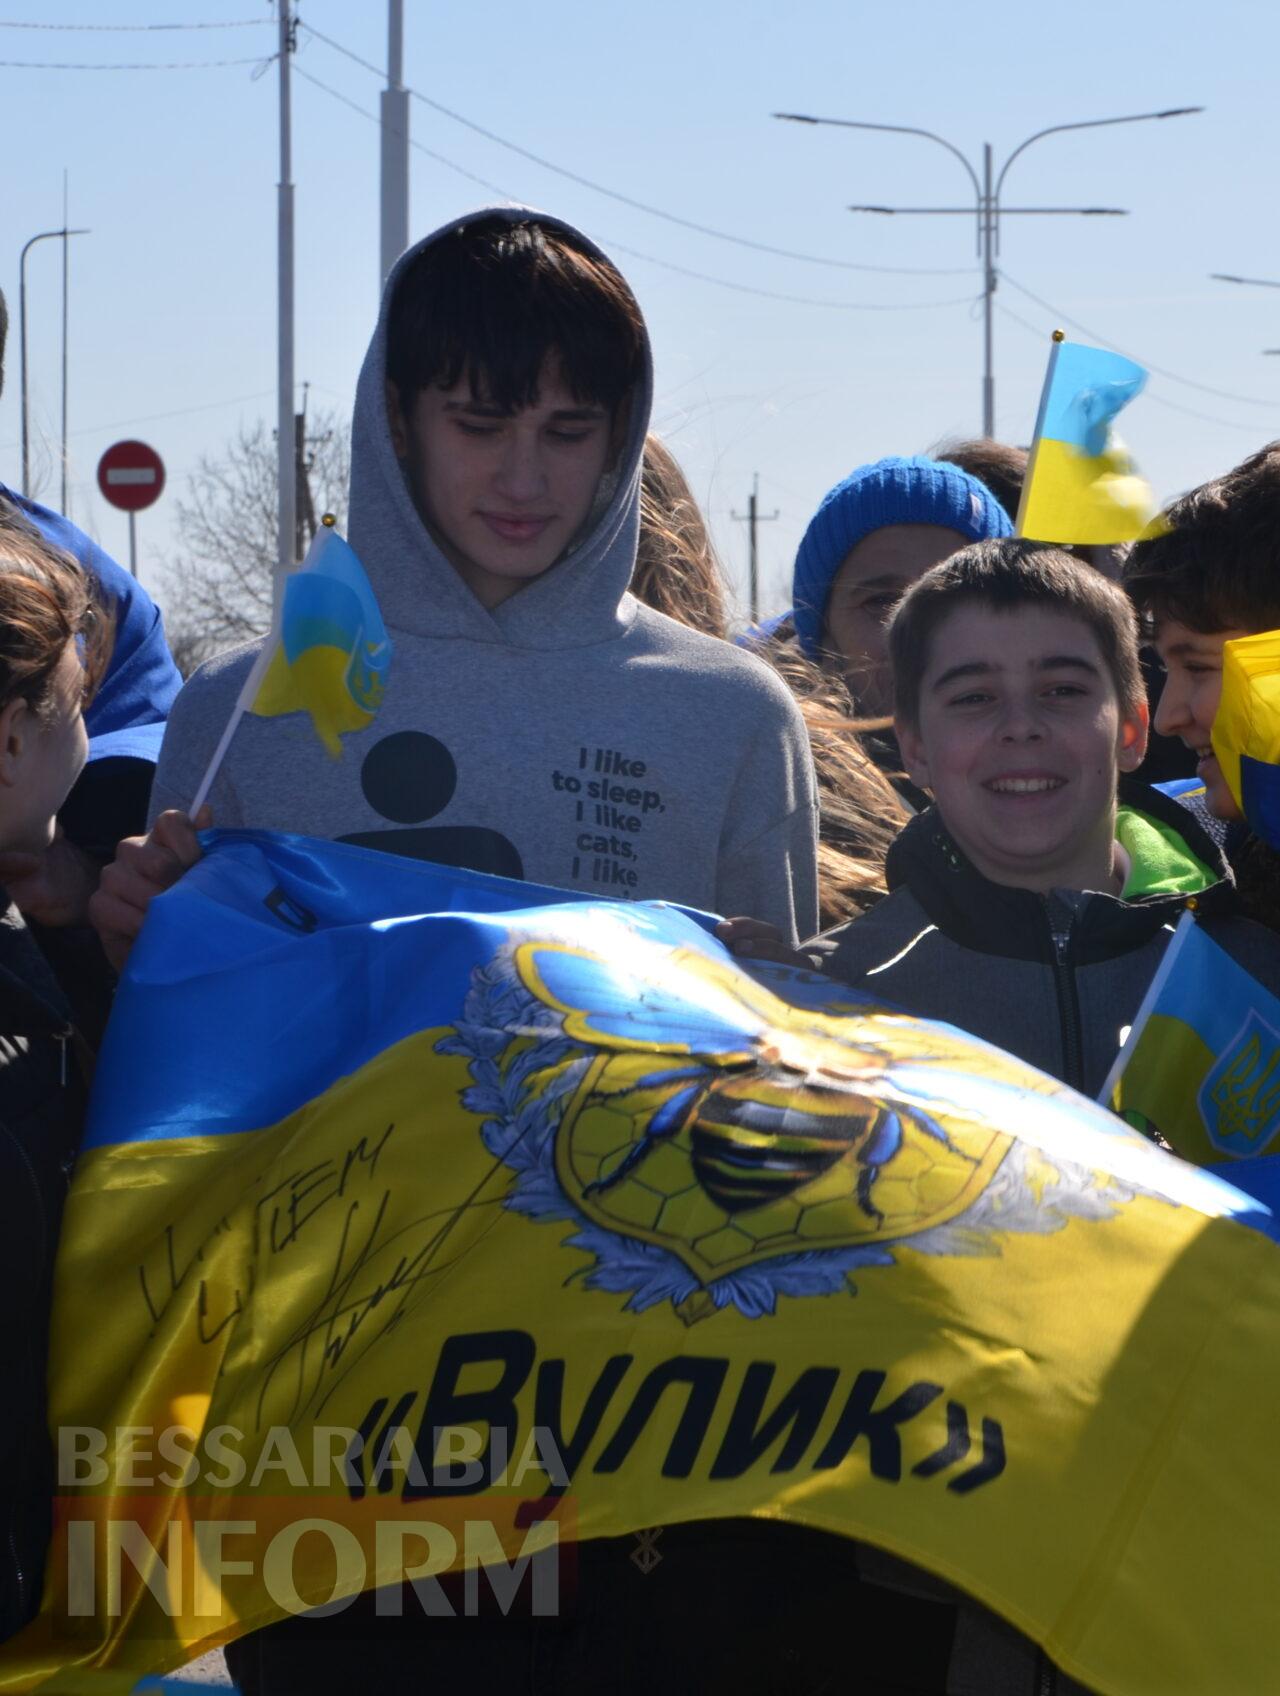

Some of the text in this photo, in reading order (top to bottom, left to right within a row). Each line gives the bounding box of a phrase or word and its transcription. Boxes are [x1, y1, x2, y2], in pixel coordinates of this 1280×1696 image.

[579, 748, 647, 778] I like
[552, 770, 666, 814] to sleep,
[576, 801, 642, 833] I like
[577, 833, 638, 862] cats,
[571, 857, 638, 888] I like
